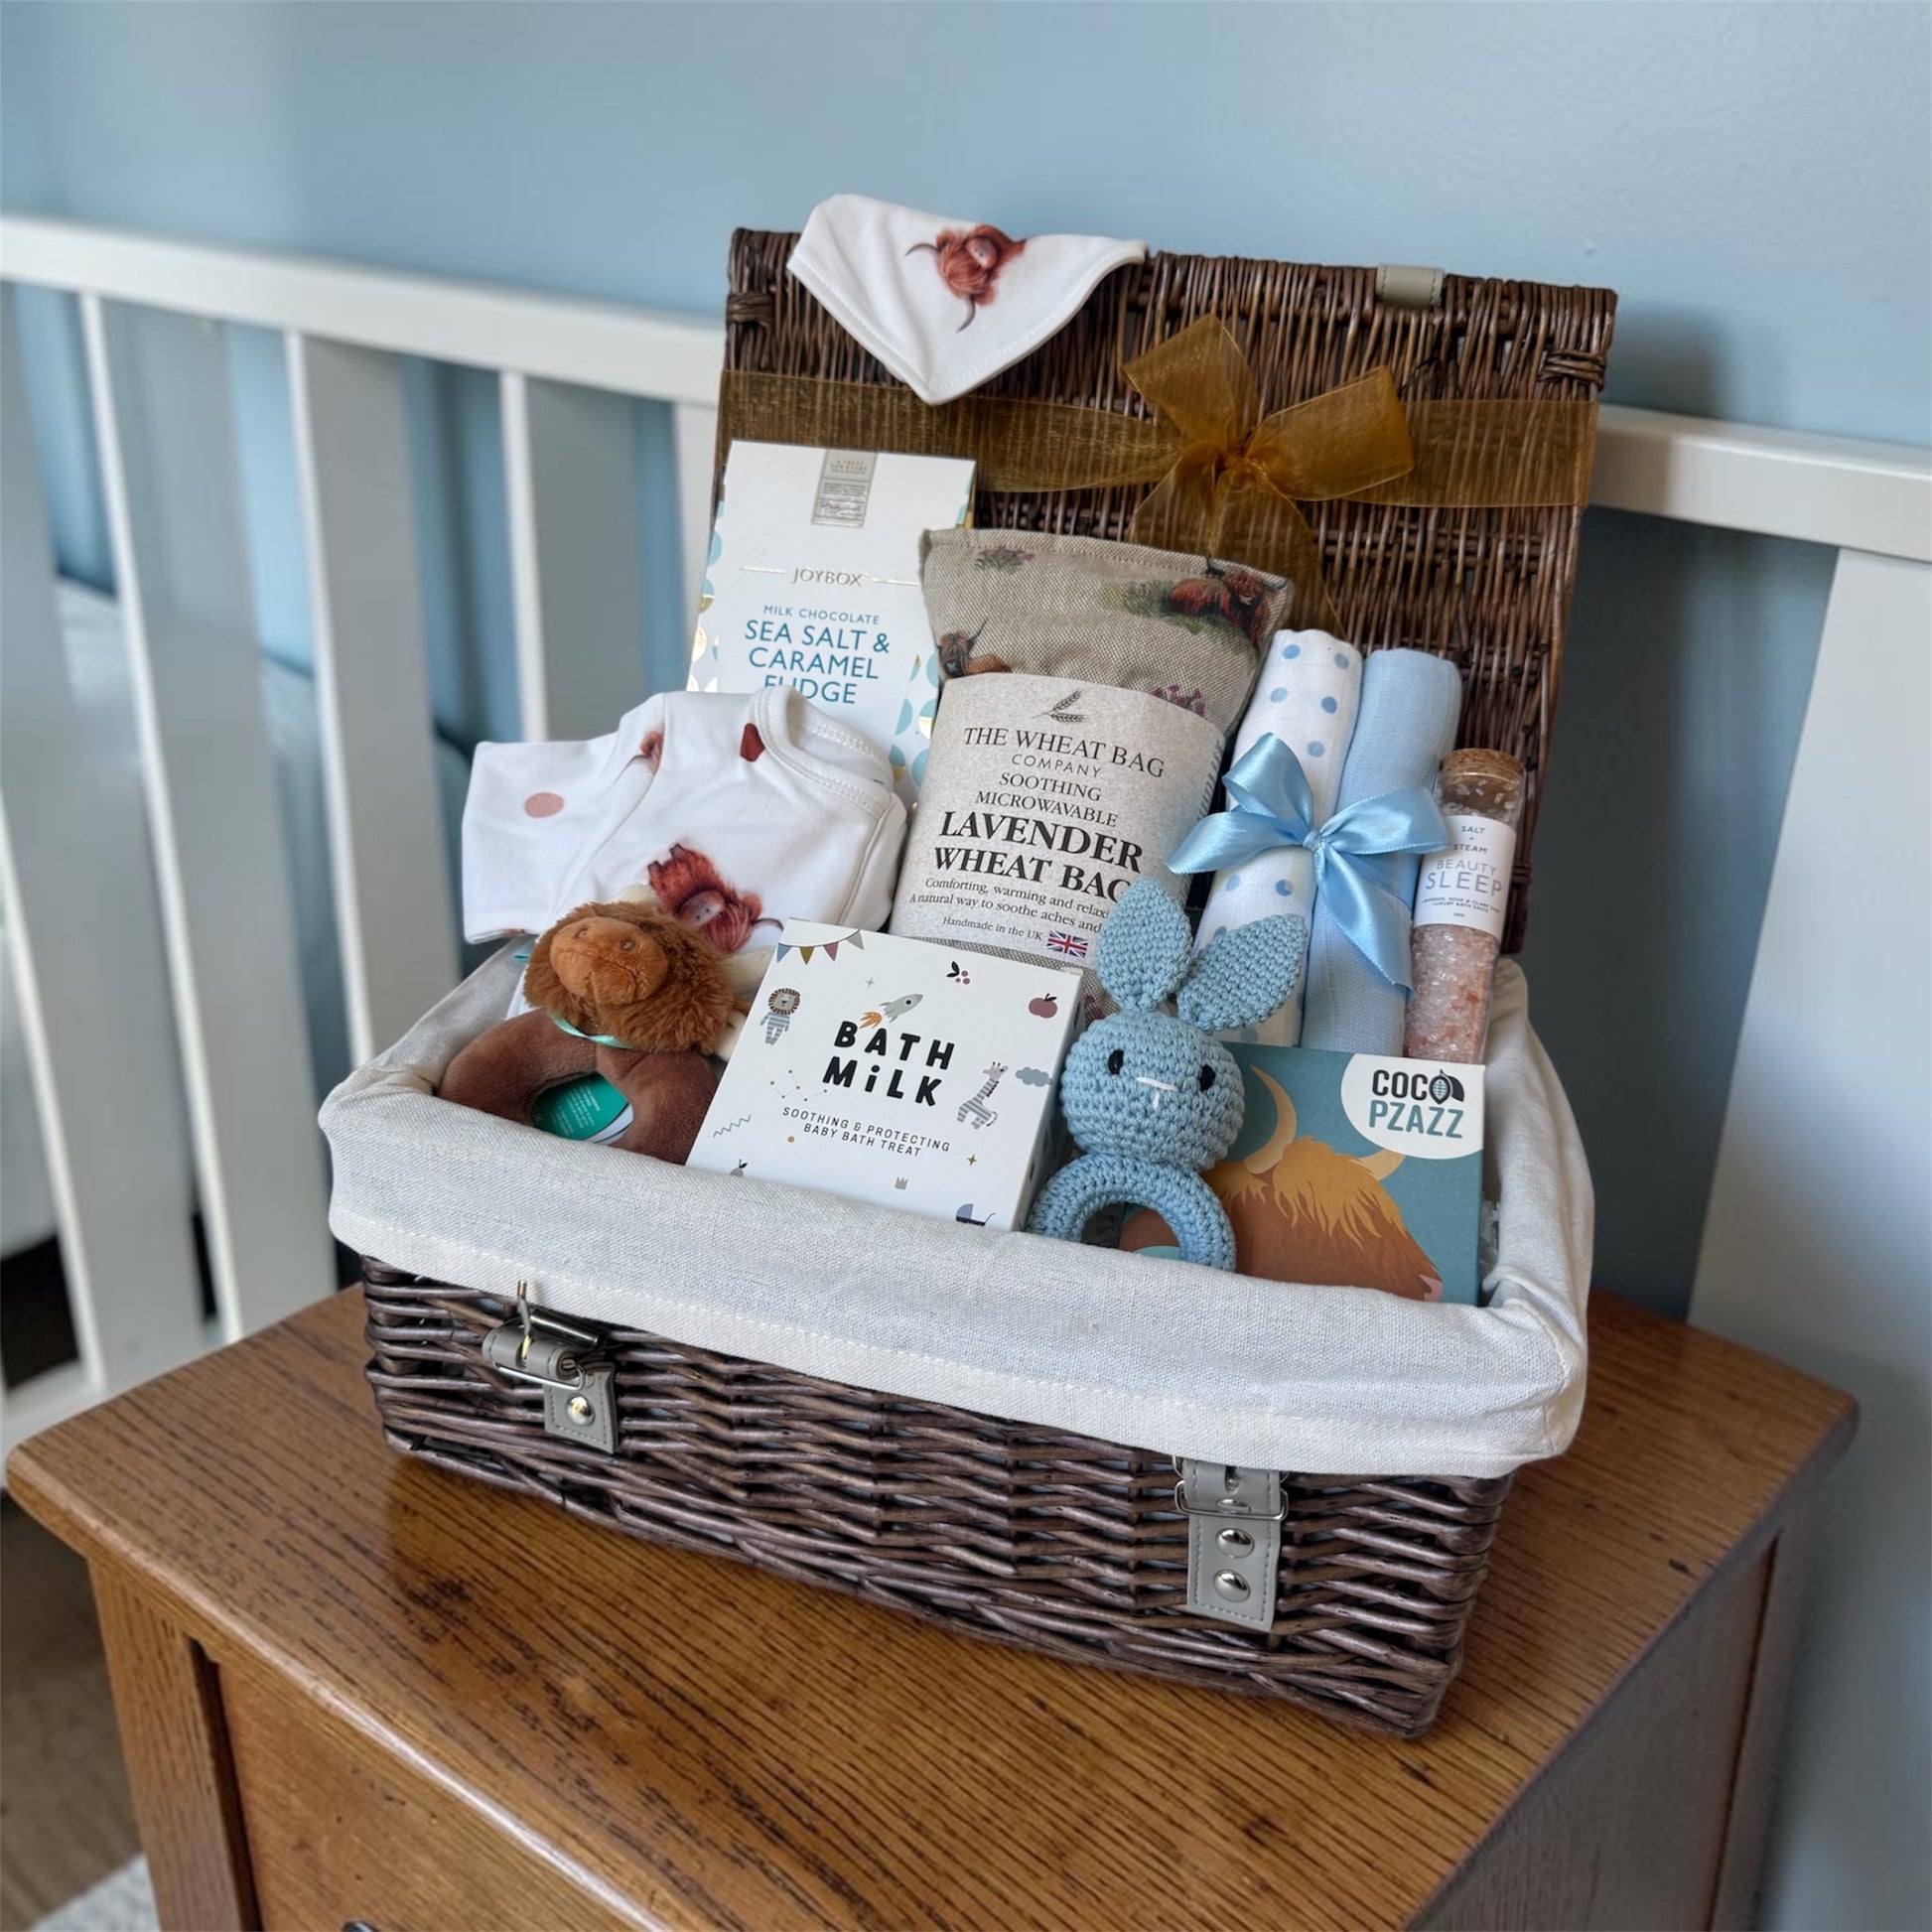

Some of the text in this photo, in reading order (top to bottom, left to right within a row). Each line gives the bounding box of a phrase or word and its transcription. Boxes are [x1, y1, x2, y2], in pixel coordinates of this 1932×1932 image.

[792, 568, 863, 587] JOYBOX
[763, 605, 880, 624] MILK CHOCOLATE
[745, 620, 890, 653] SEA SALT &
[749, 647, 879, 679] CARAMEL
[964, 727, 1166, 778] THE WHEAT BAG
[1011, 754, 1102, 778] COMPANY
[999, 771, 1102, 802] SOOTHING
[975, 790, 1118, 828] MICROWAVABLE
[938, 810, 1143, 873] LAVENDER
[1460, 825, 1486, 834] SALT
[1452, 843, 1488, 854] STEAM
[934, 847, 1052, 884] WHEAT
[1436, 858, 1497, 876] BEAUTY
[925, 878, 989, 895] Comforting,
[993, 885, 1046, 905] warming
[1048, 896, 1073, 909] and
[1425, 870, 1502, 897] SLEEP
[909, 894, 1102, 933] A natural way to soothe aches and
[942, 916, 1043, 941] Handmade in the UK
[834, 1020, 955, 1071] BATH
[1372, 1069, 1455, 1104] COCO
[781, 1106, 951, 1153] SOOTHING & PROTECTING
[1369, 1099, 1464, 1139] PZAZZ
[803, 1123, 921, 1158] BABY BATH TREAT
